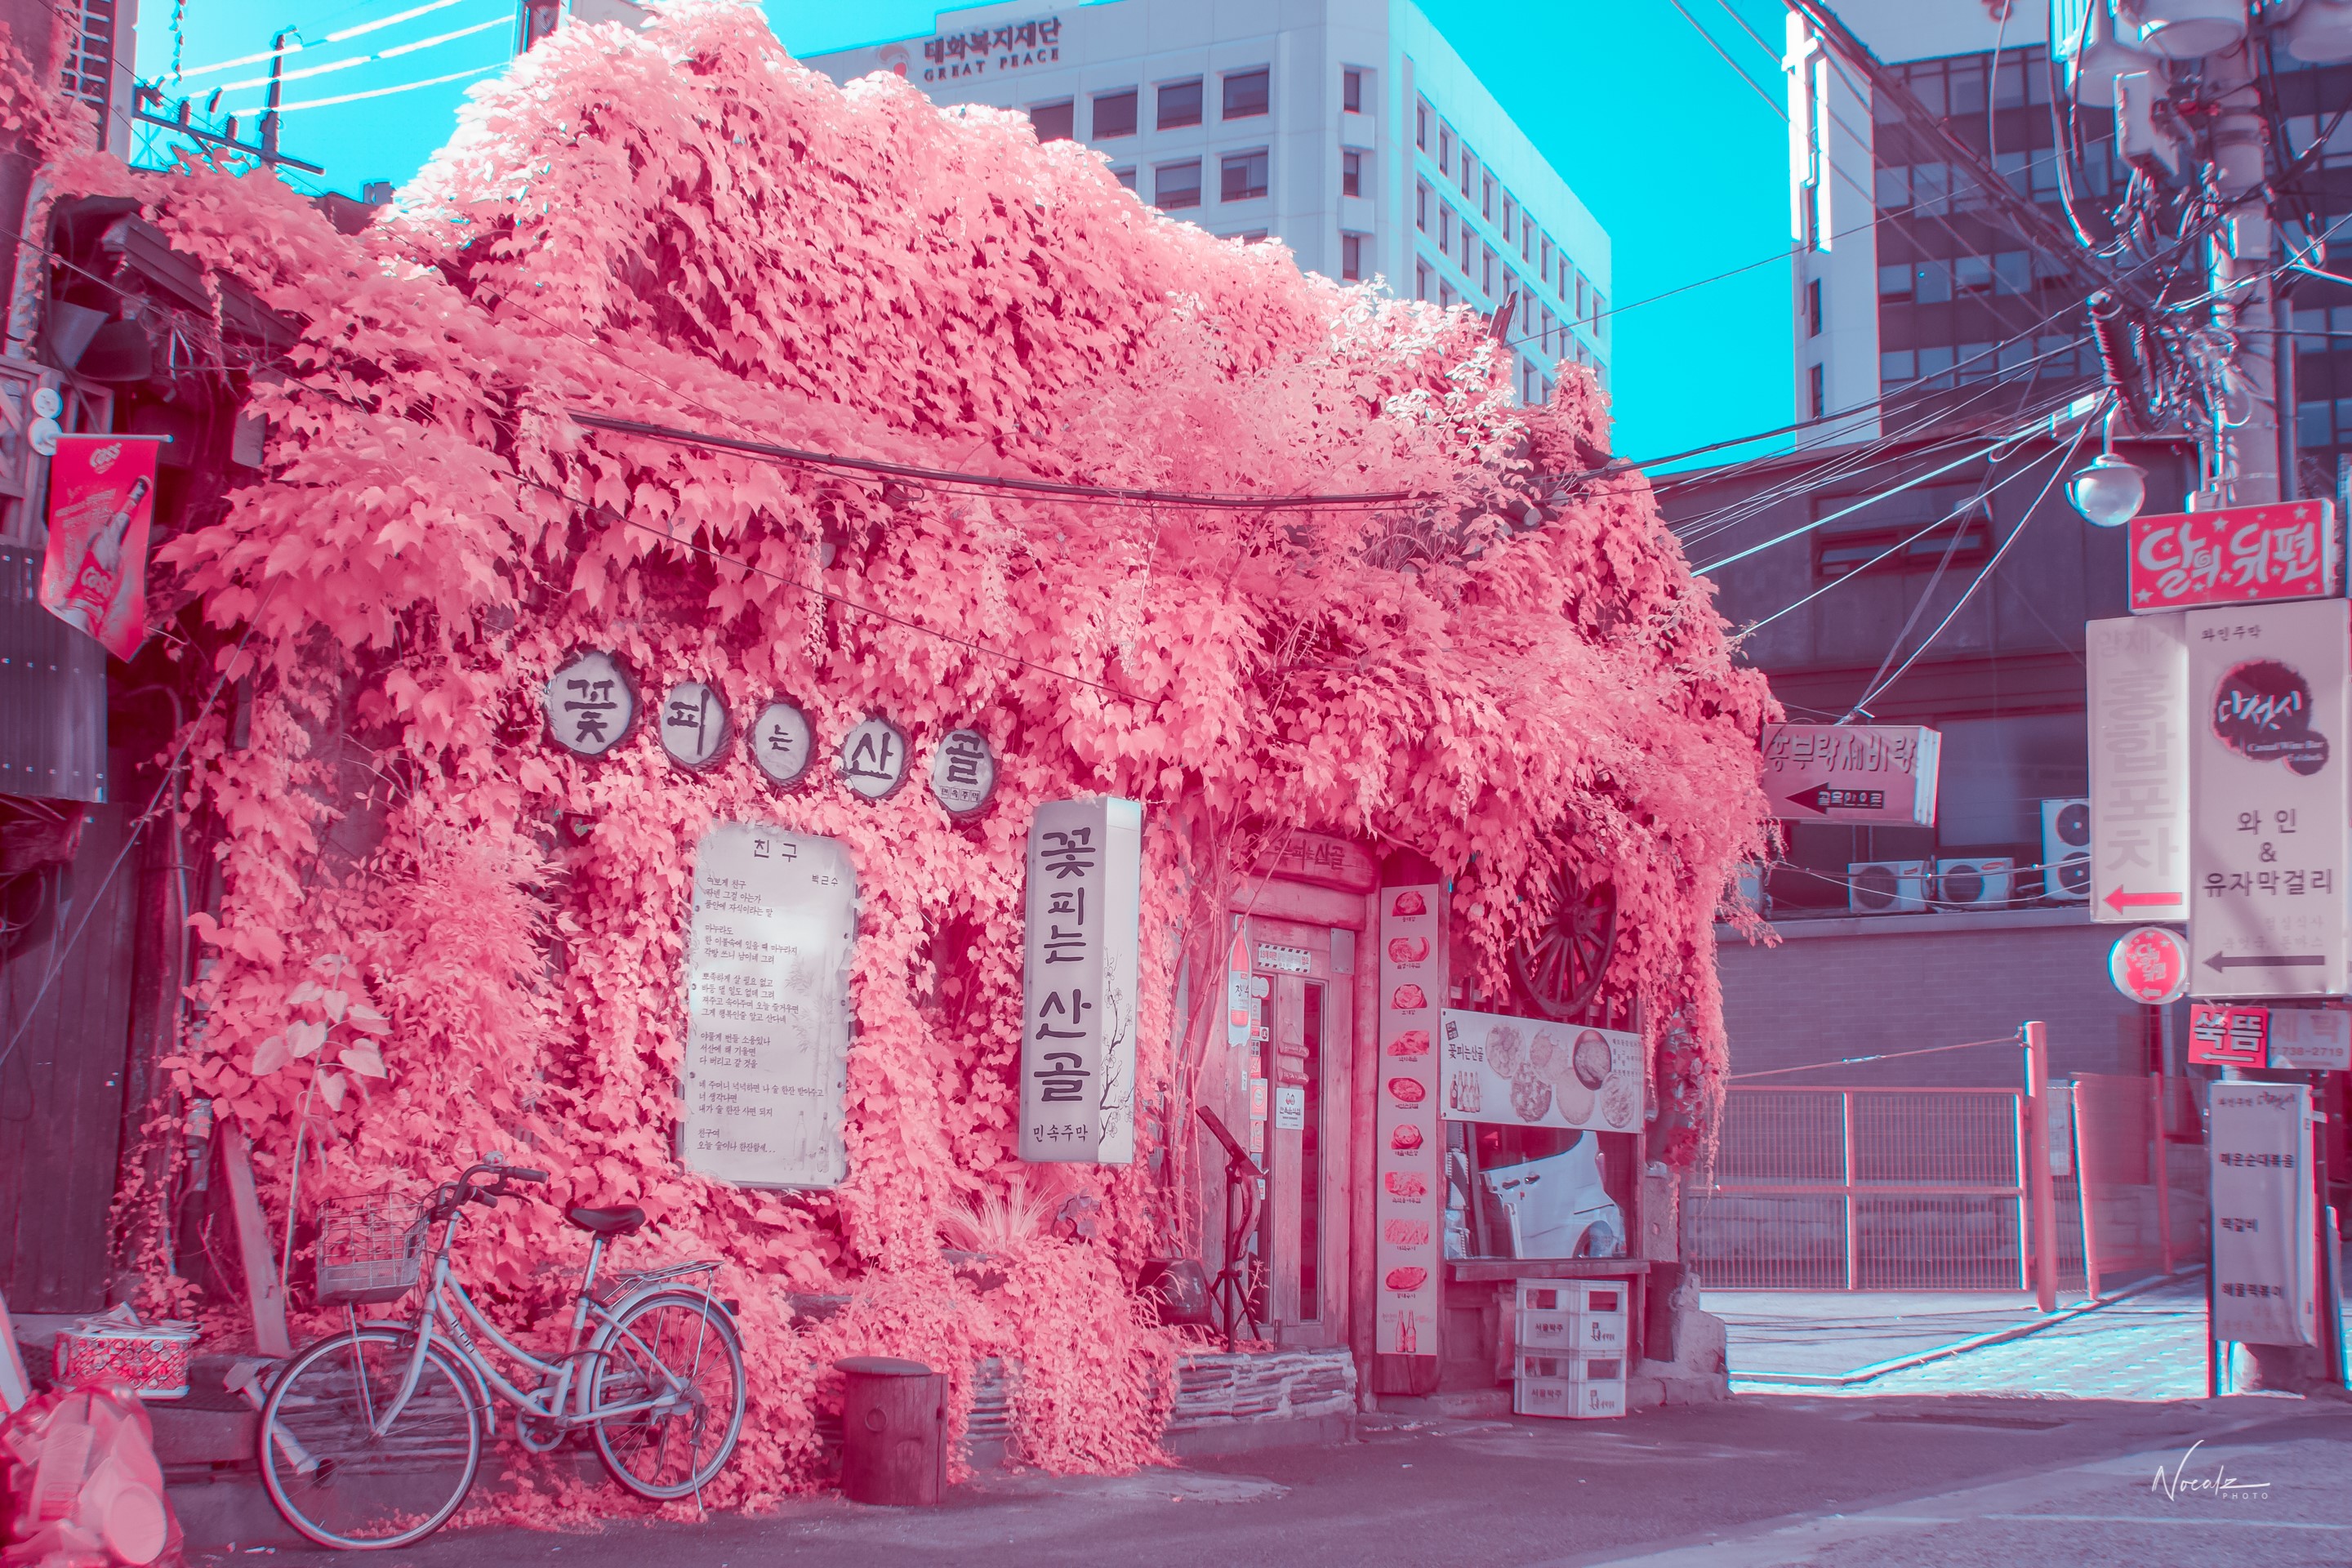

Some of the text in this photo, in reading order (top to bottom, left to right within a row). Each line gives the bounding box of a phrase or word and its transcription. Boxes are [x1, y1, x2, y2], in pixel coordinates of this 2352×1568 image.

[924, 15, 1062, 65] 태화복지재단
[924, 47, 1060, 82] GREAT PEACE
[2137, 521, 2320, 599] 달의 뒤편
[2201, 624, 2262, 642] 와인주막
[2237, 808, 2297, 835] 와인
[754, 839, 798, 862] 친구
[2258, 842, 2278, 863] &
[732, 880, 746, 889] 친구
[811, 874, 840, 887] 박근수
[2202, 868, 2333, 898] 유자막걸리
[723, 891, 737, 902] 그걸
[740, 893, 762, 904] 아는가
[705, 899, 773, 918] 품안에 자식이라는 말
[705, 923, 734, 935] 마누라도
[705, 935, 712, 945] 한
[746, 940, 760, 951] 있을
[761, 942, 768, 951] 때
[770, 944, 798, 956] 마누라지
[704, 947, 775, 964] 각방 쓰니 남이네 그려
[733, 975, 742, 985] 살
[743, 976, 758, 987] 필요
[760, 978, 773, 988] 없고
[728, 986, 742, 996] 일도
[760, 990, 775, 1000] 그려
[755, 1001, 770, 1011] 오늘
[772, 1003, 800, 1014] 즐거우면
[701, 1008, 786, 1024] 그게 행복인줄 알고 산다네
[2193, 1011, 2265, 1052] 쑥뜸
[742, 1035, 771, 1046] 소용있나
[700, 1043, 722, 1054] 서산에
[734, 1046, 756, 1057] 기울면
[1448, 1043, 1484, 1062] 꽃피는산골
[699, 1055, 758, 1069] 다 버리고 갈 것을
[708, 1080, 730, 1090] 주머니
[733, 1082, 760, 1094] 넉넉하면
[763, 1085, 770, 1094] 나
[772, 1085, 779, 1094] 술
[782, 1085, 795, 1096] 한잔
[797, 1087, 824, 1098] 받아주고
[699, 1092, 737, 1103] 너 생각나면
[699, 1104, 773, 1117] 내가 술 한잔 사면 되지
[697, 1128, 720, 1138] 친구여
[1032, 1125, 1089, 1143] 민속주막
[697, 1140, 713, 1151] 오늘
[715, 1141, 737, 1152] 술이나
[1535, 1323, 1563, 1332] 서울탁주
